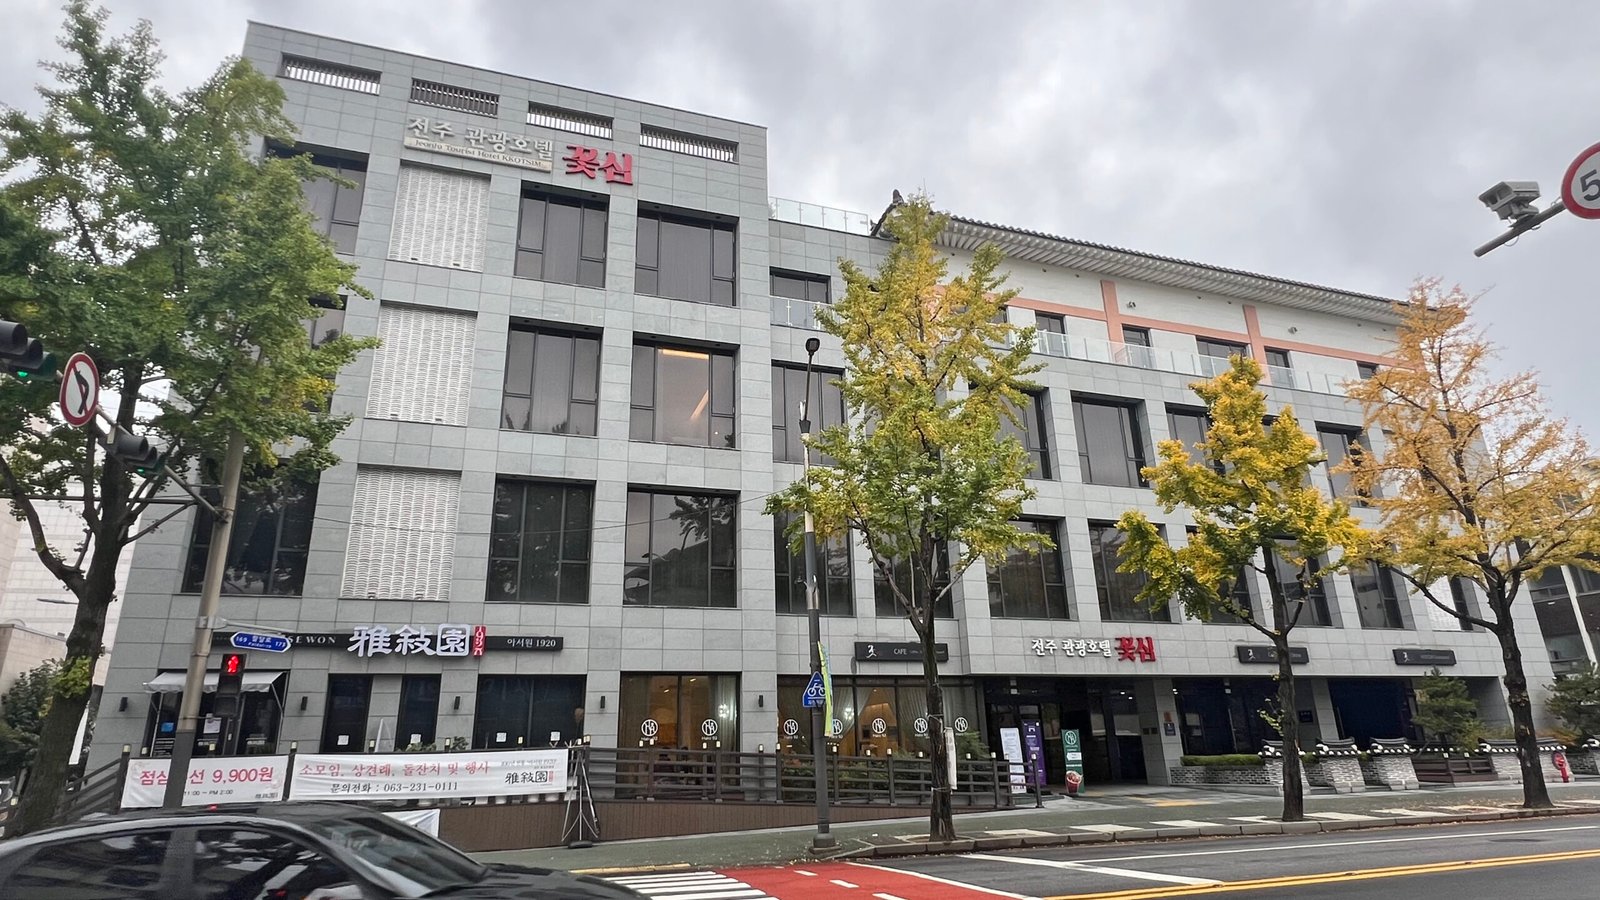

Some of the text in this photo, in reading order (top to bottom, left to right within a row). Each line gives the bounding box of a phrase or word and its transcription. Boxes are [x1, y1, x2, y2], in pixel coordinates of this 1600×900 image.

[408, 117, 633, 185] 전주 관광호텔 꽃심
[415, 140, 542, 167] Jeonju Tourist Hotel KKOTSIM
[507, 638, 556, 648] 아서원 1920
[1031, 637, 1156, 662] 전주 관광호텔 꽃심
[212, 767, 274, 783] 9,900원
[403, 762, 440, 776] 돌잔치
[448, 762, 459, 775] 및
[465, 761, 490, 774] 행사
[330, 783, 371, 793] 문의전화
[384, 782, 458, 792] 063-231-0111
